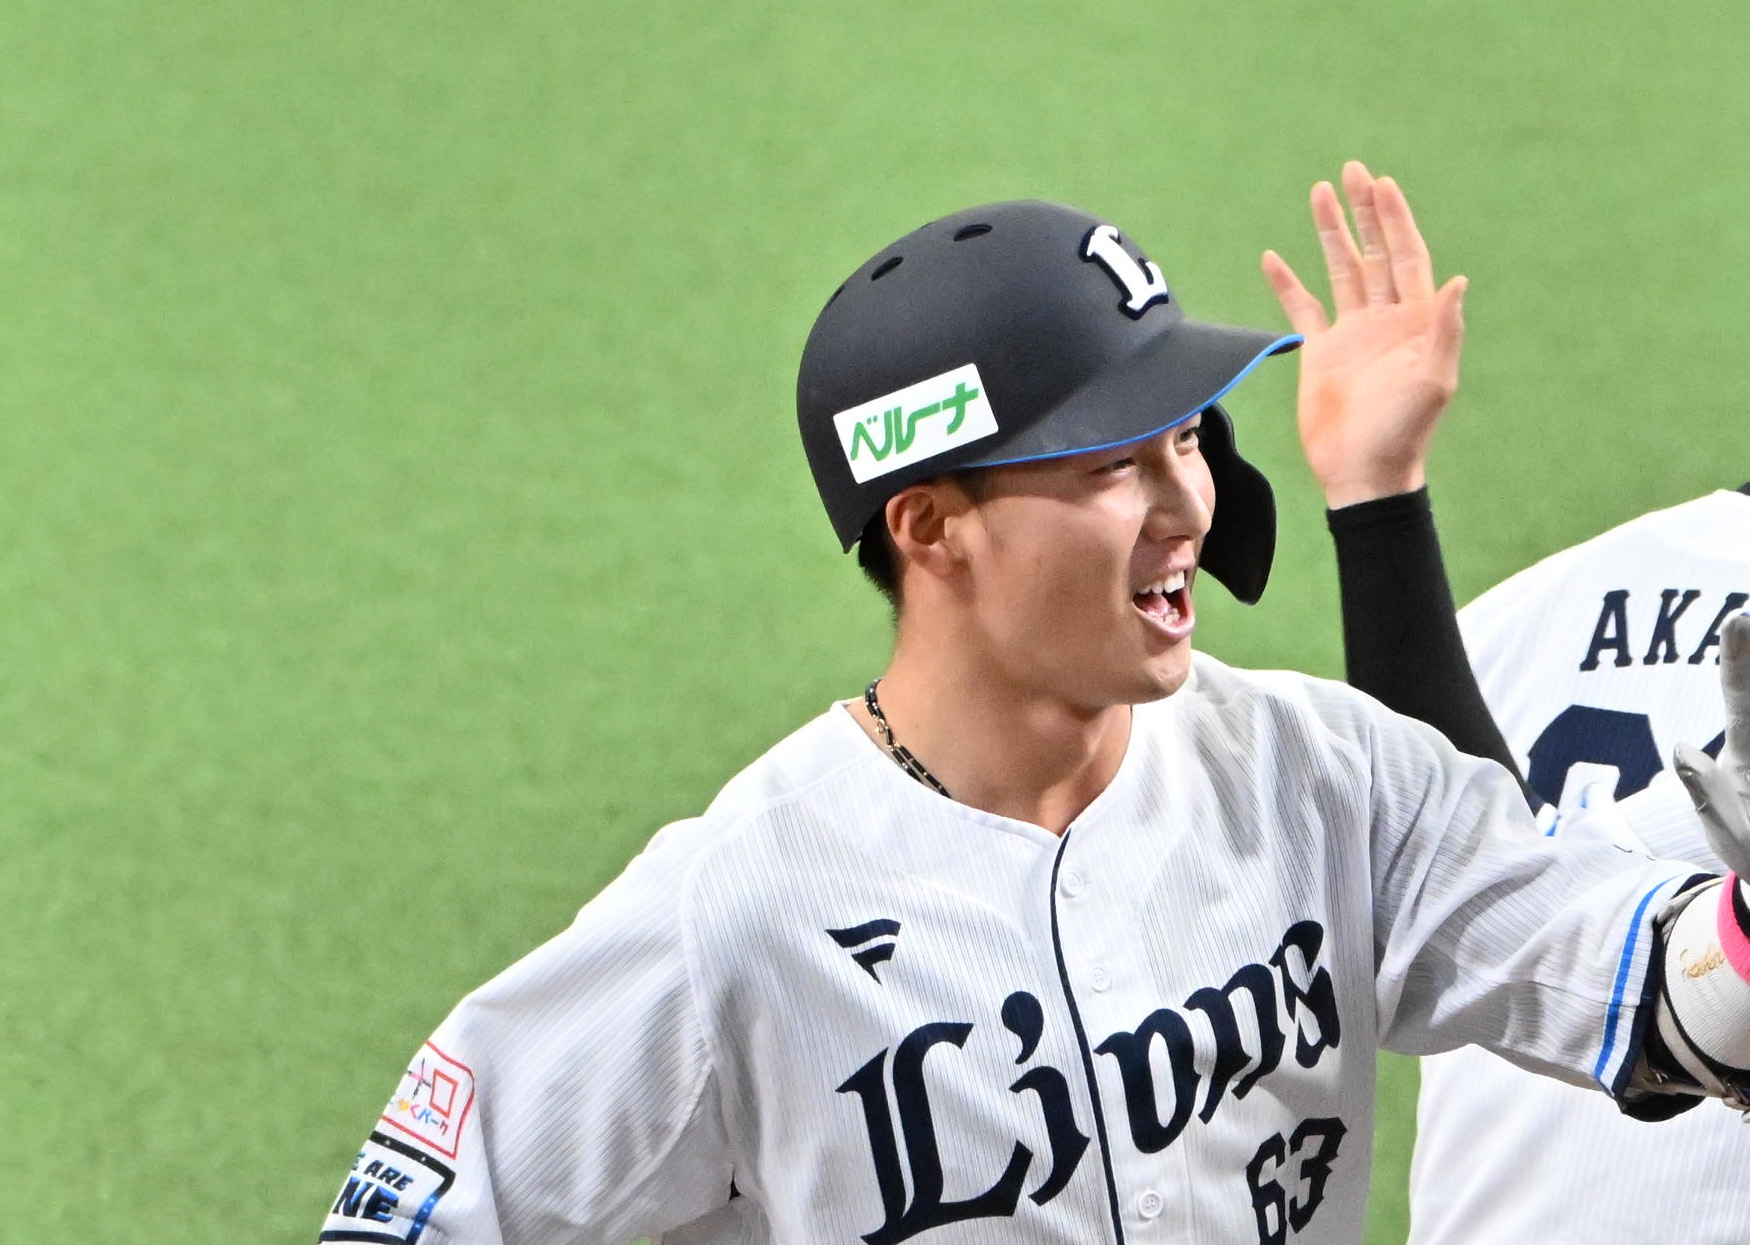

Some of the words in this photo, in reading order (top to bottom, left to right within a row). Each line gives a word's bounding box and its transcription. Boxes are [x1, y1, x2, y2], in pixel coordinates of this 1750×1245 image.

[1079, 225, 1169, 320] L
[849, 381, 980, 462] ベルーナ
[332, 1176, 399, 1224] NE
[363, 1159, 415, 1192] ARE
